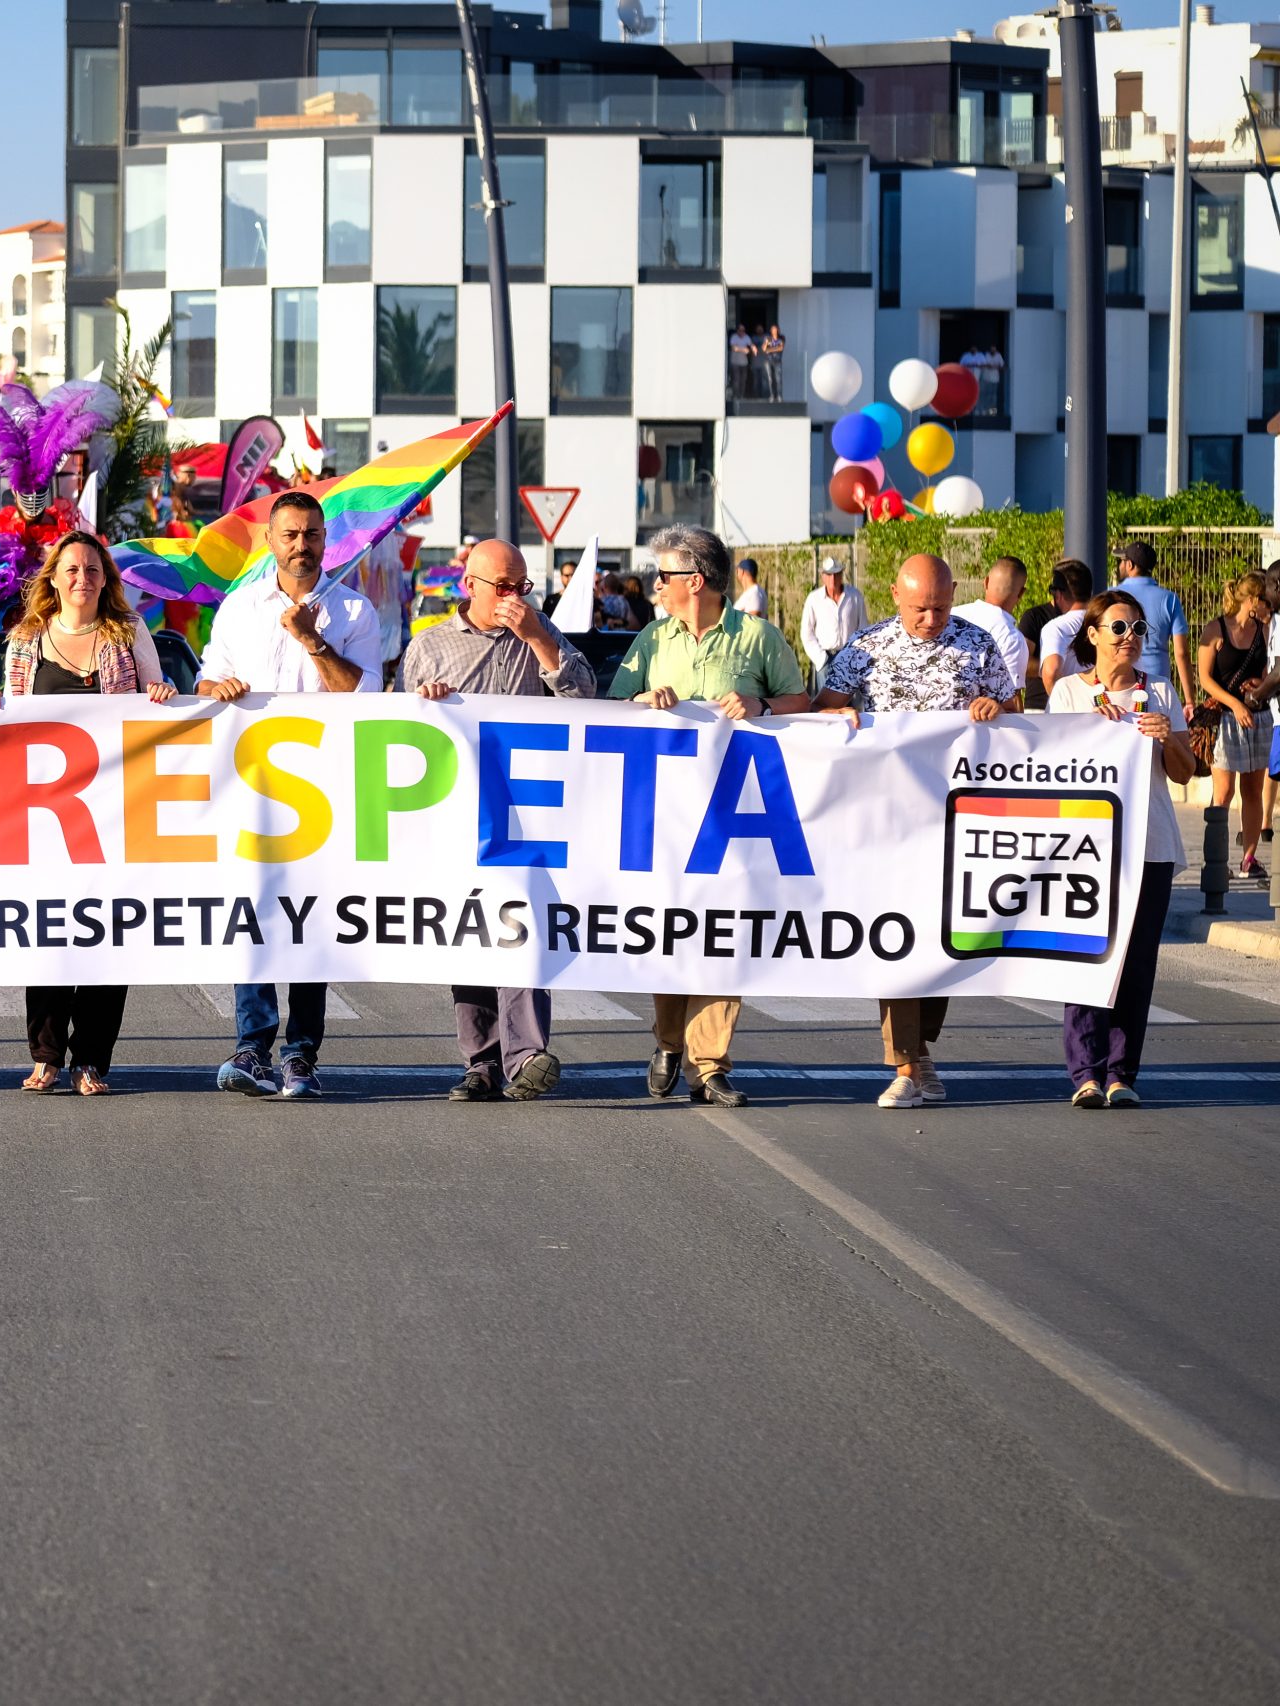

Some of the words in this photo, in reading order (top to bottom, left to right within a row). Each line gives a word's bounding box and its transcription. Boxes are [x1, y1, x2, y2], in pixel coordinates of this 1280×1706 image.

[952, 757, 1118, 784] Asociación
[964, 829, 1101, 862] IBIZA
[962, 871, 1100, 919] LGTB
[277, 895, 318, 945] Y
[336, 888, 529, 947] SERÁS
[548, 903, 915, 962] RESPETADO
